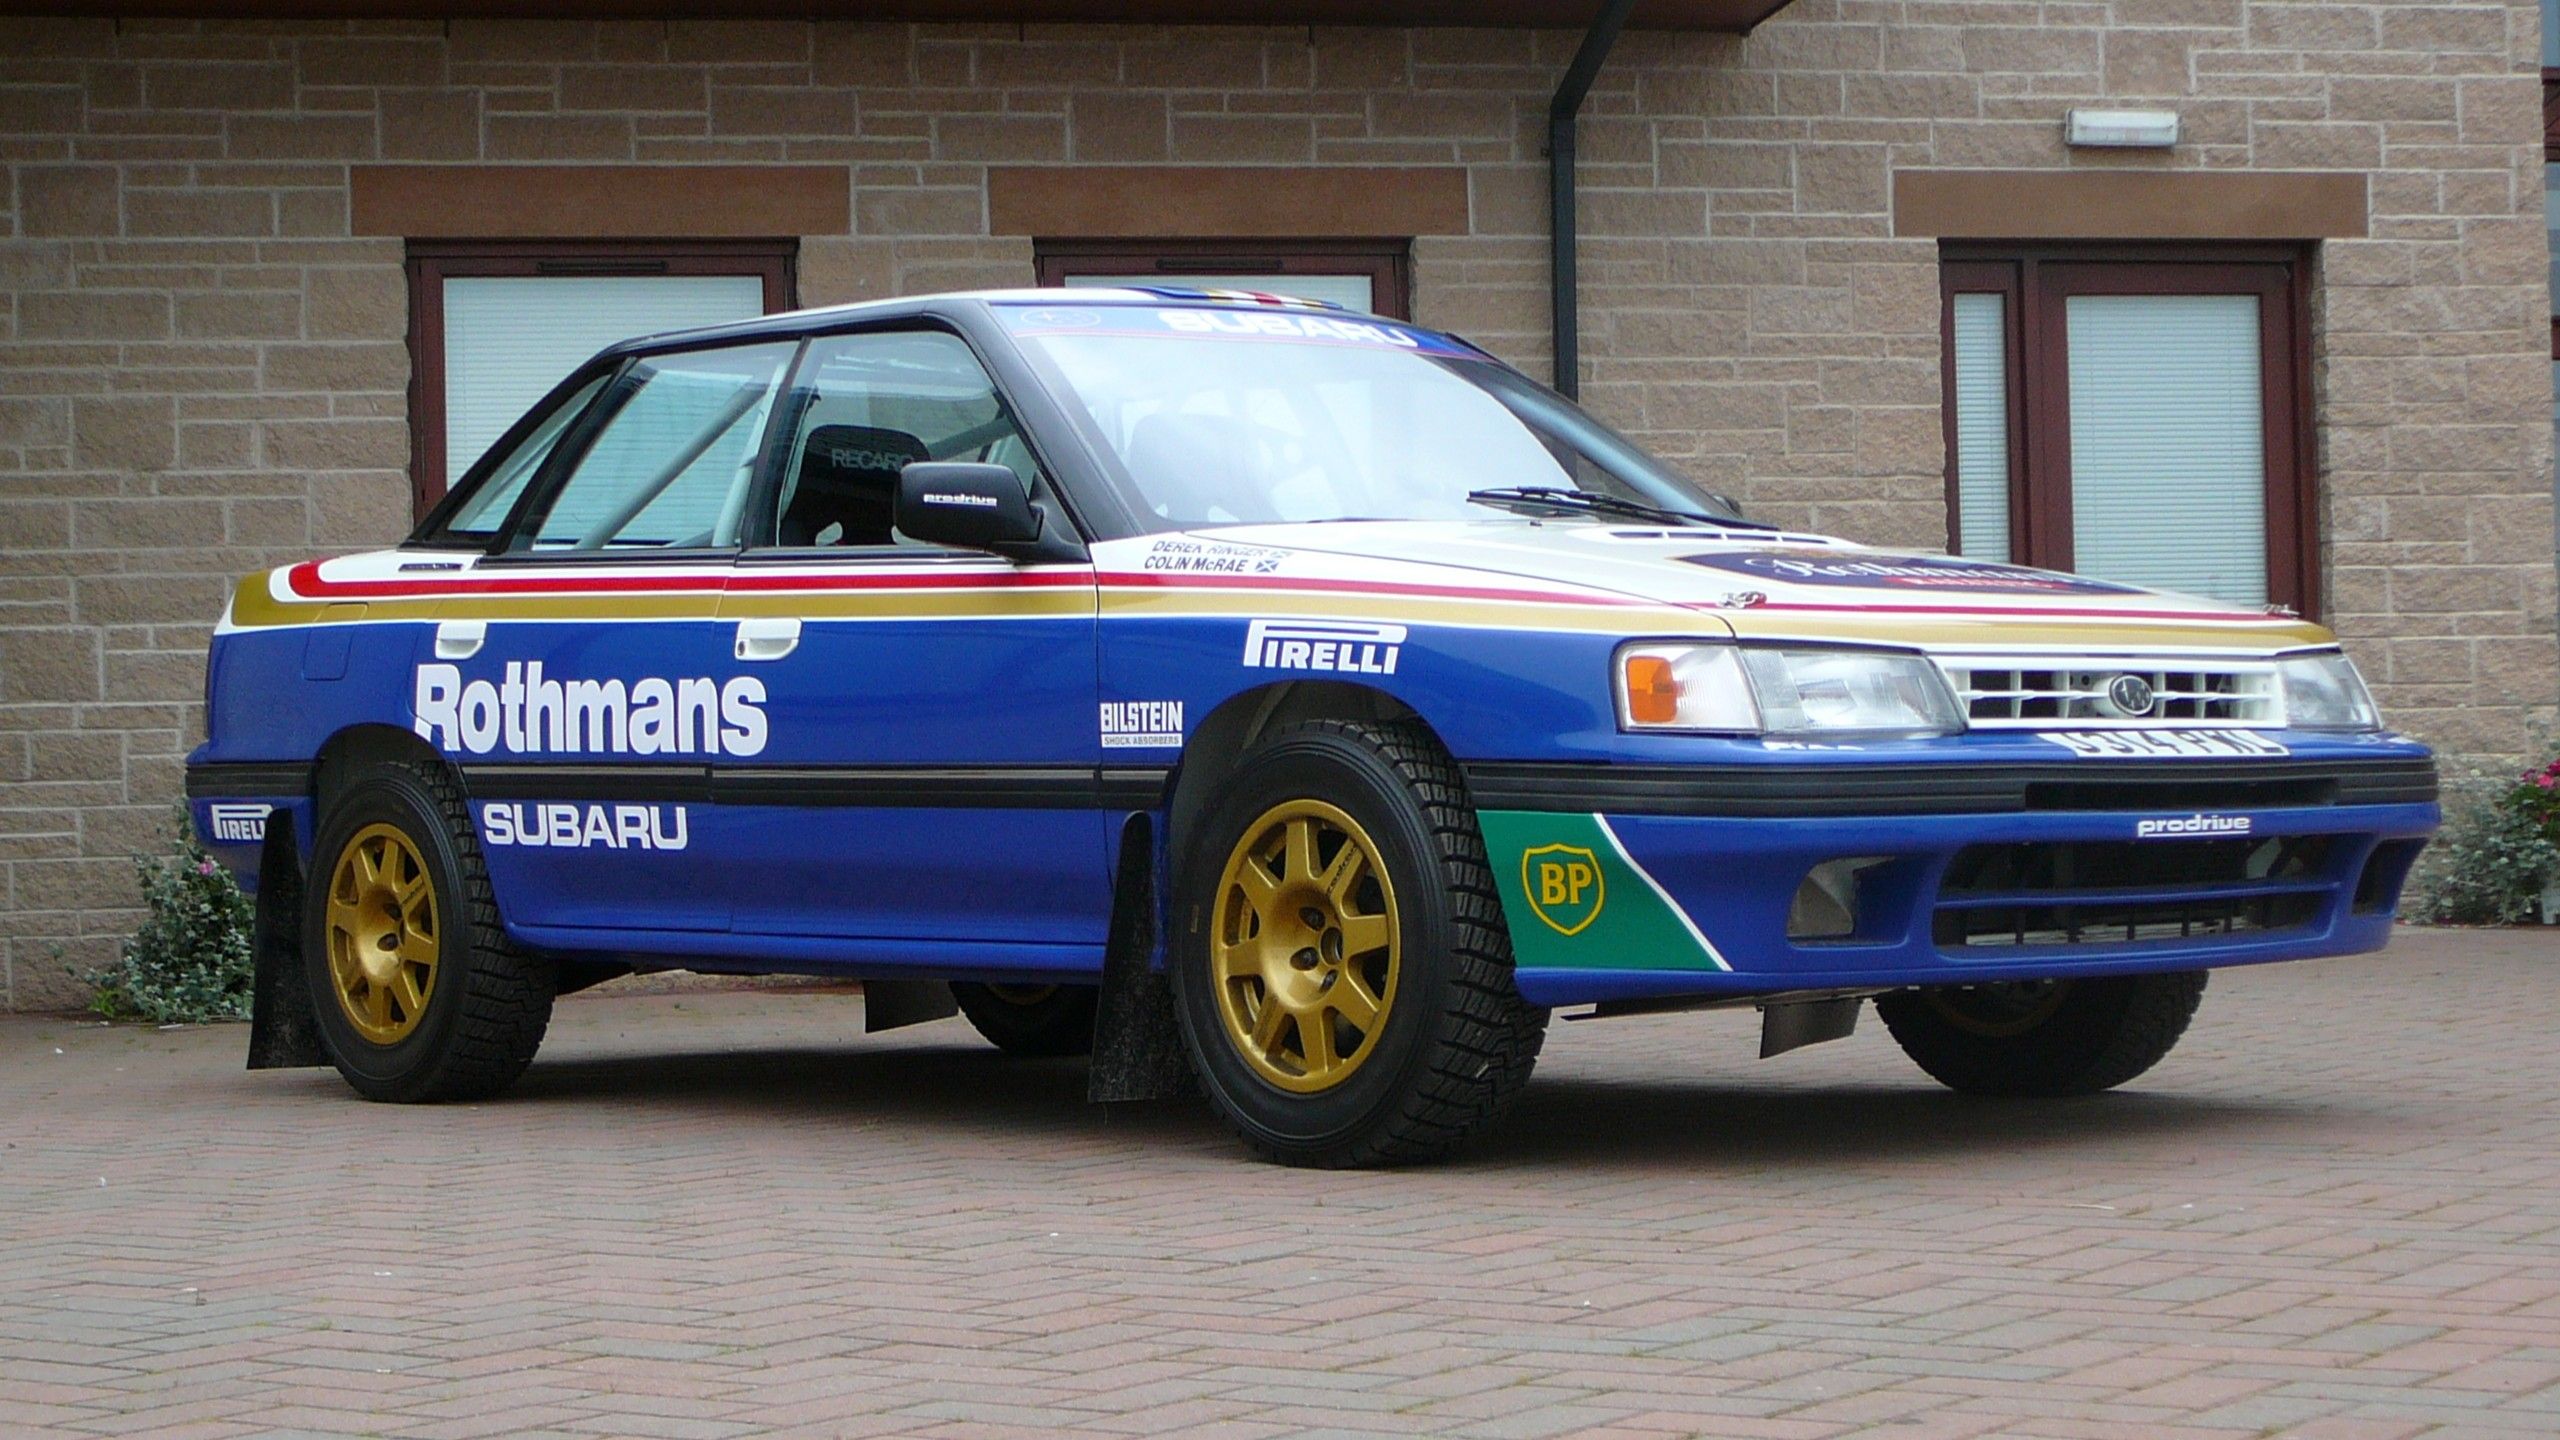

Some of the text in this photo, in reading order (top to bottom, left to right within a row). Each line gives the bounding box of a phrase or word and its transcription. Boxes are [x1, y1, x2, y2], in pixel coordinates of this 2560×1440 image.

[1158, 310, 1419, 347] SUBARU
[1144, 555, 1248, 572] COLIN McRAE
[1243, 618, 1408, 675] PIRELLI
[413, 660, 769, 756] Rothmans
[1099, 701, 1183, 732] BILSTEIN
[1104, 735, 1180, 746] SHOCK ABSORBERS
[483, 803, 688, 850] SUBARU
[2138, 815, 2250, 838] prodrive
[1540, 862, 1593, 905] BP
